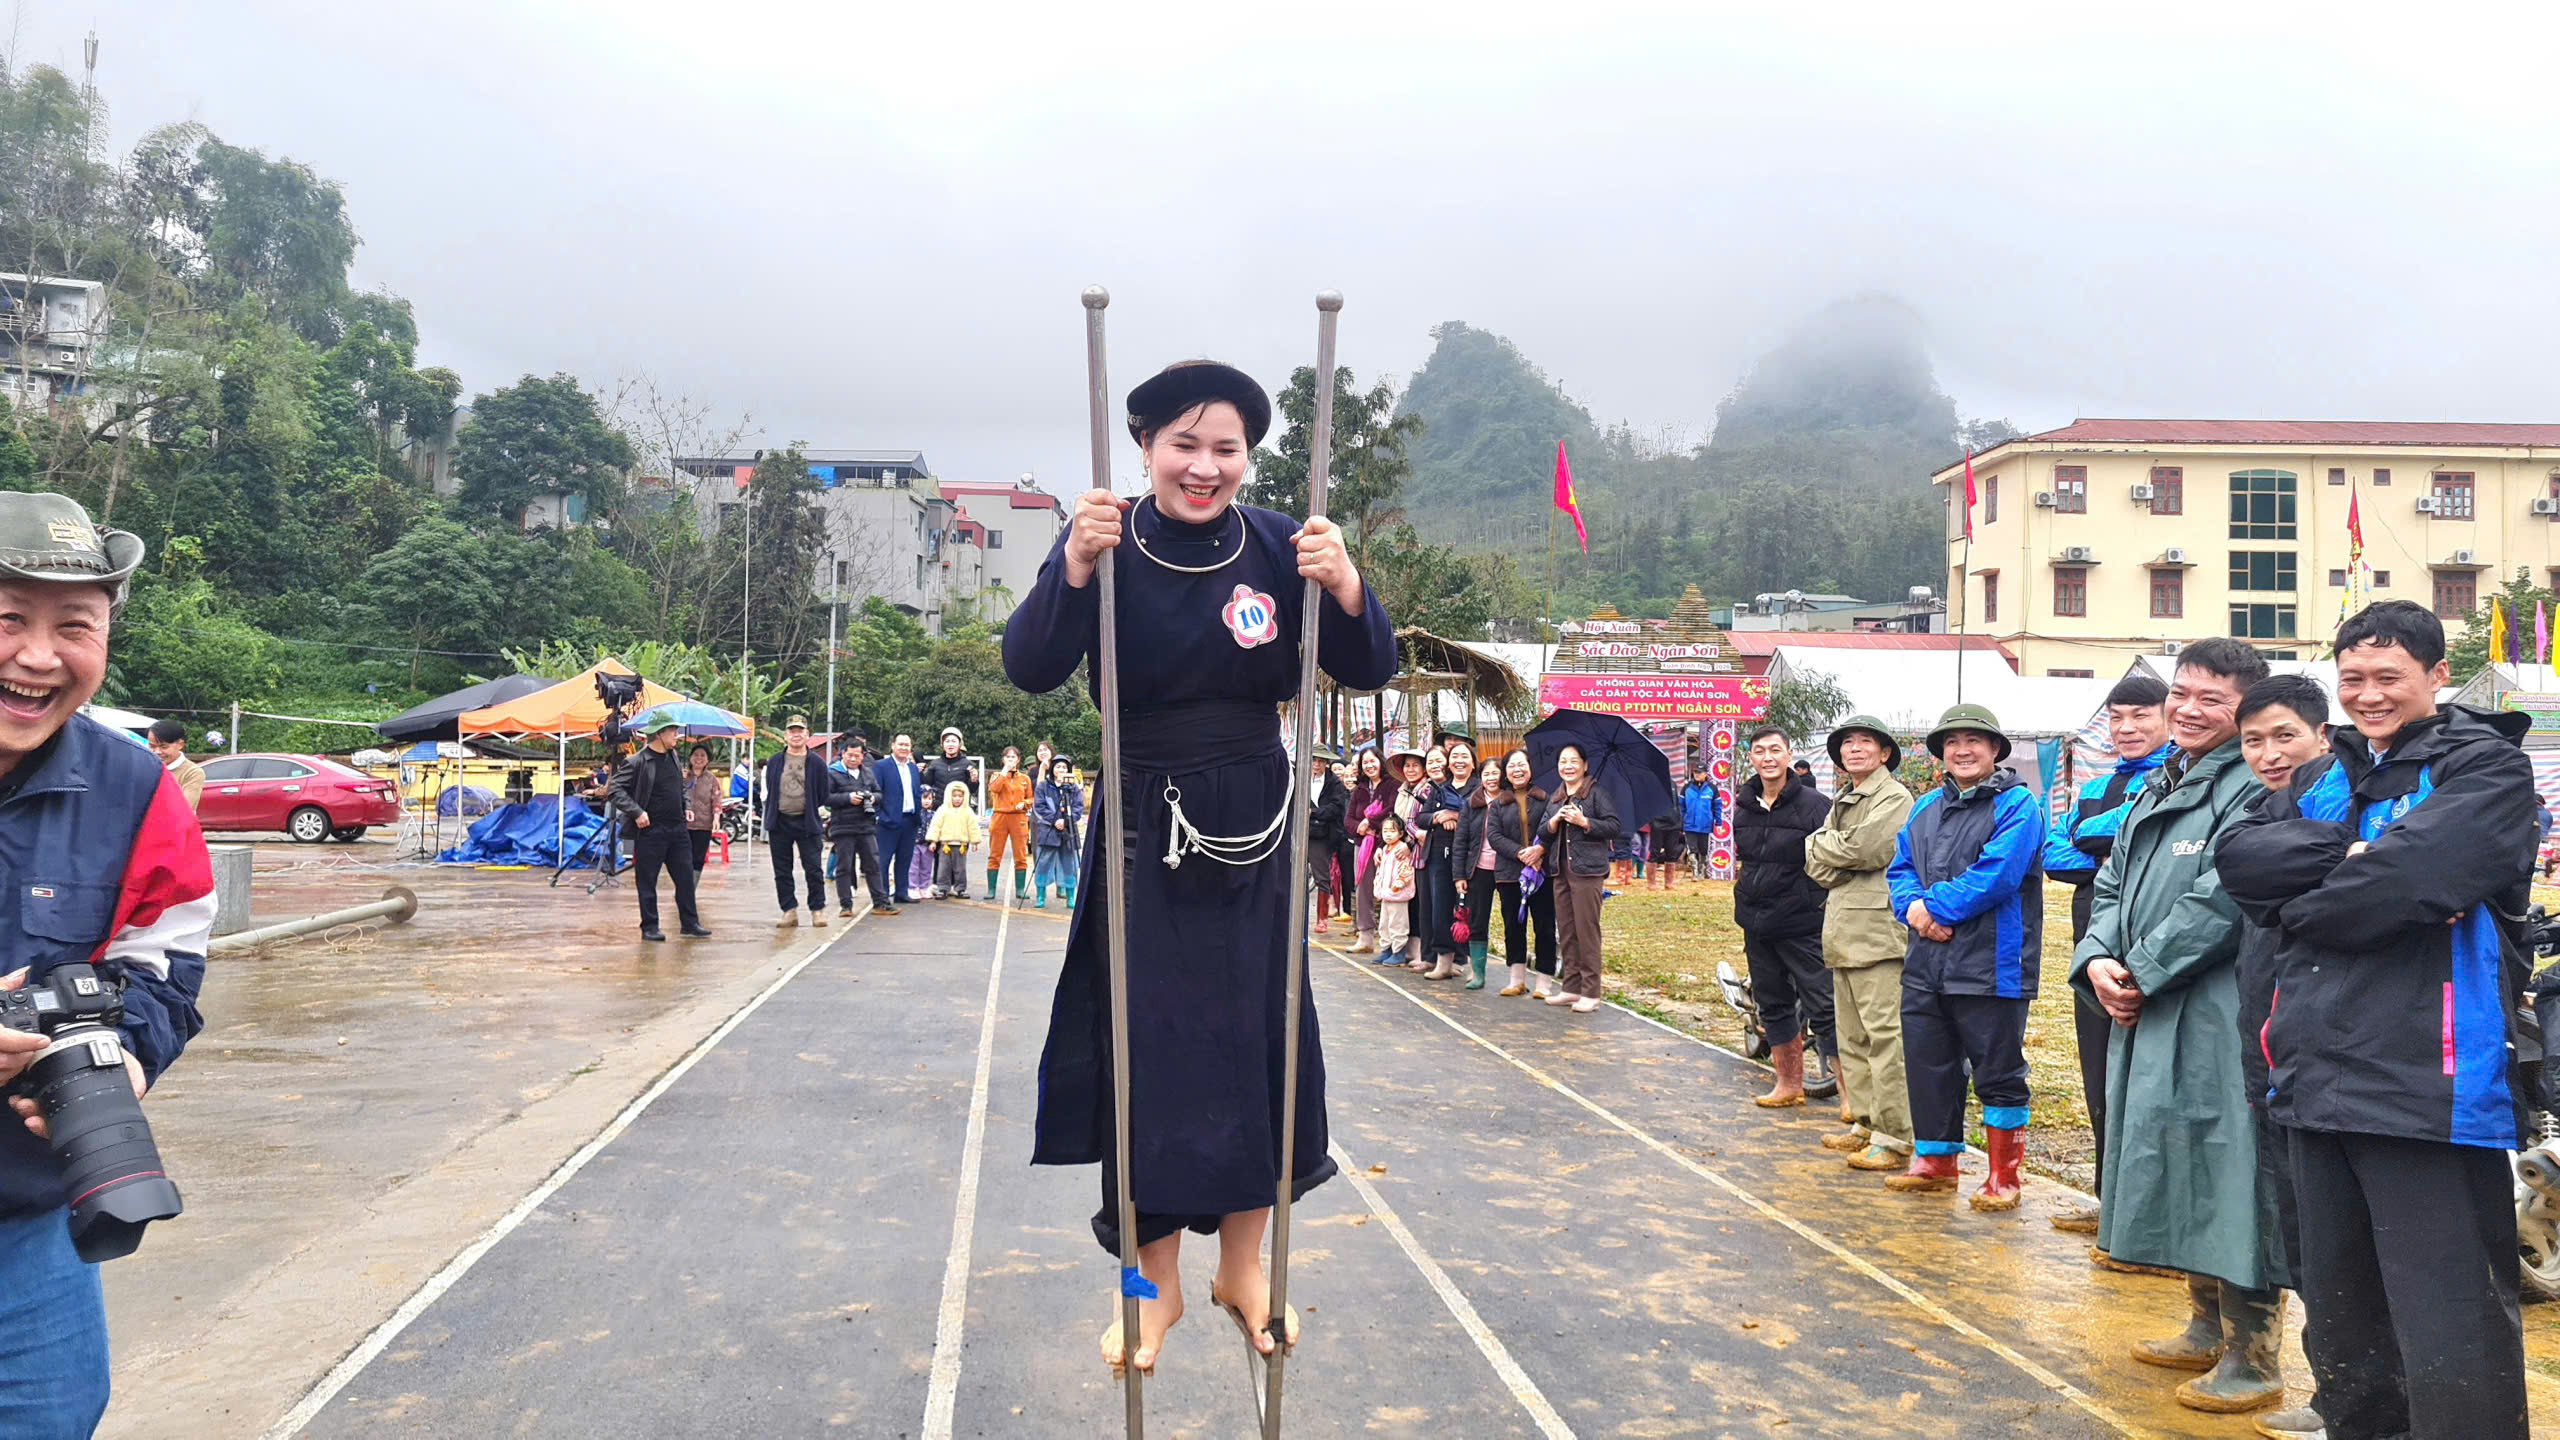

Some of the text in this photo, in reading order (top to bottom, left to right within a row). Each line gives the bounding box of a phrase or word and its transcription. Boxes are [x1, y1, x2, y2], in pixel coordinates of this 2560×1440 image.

[1237, 605, 1264, 630] 10
[1586, 622, 1639, 634] Hội Xuân
[1580, 642, 1718, 660] Sắc Đào Ngân Sơn
[1595, 678, 1635, 687] KHÔNG
[1637, 680, 1664, 688] GIAN
[1667, 680, 1689, 689] VĂN
[1580, 688, 1603, 697] CÁC
[1606, 688, 1629, 697] DÂN
[1632, 689, 1653, 699] TỘC
[1673, 689, 1704, 699] NGÂN
[1707, 691, 1730, 699] SƠN
[1568, 700, 1742, 714] TRƯỜNG PTDTNT NGÂN SƠN
